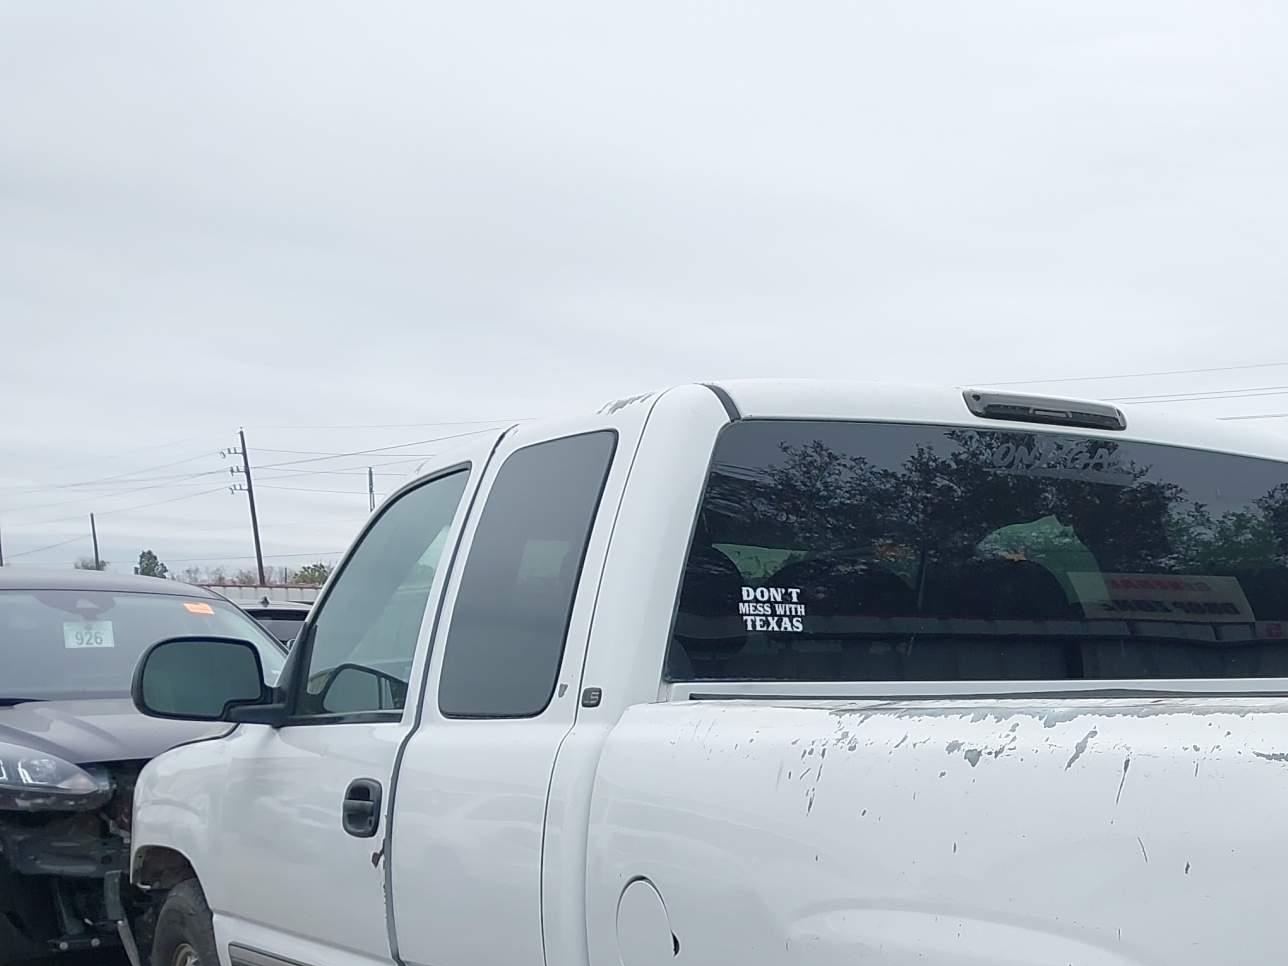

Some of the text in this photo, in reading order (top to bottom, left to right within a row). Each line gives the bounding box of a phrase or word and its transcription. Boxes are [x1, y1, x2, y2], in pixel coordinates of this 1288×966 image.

[741, 586, 801, 602] DON'T
[739, 602, 806, 616] MESS WITH
[742, 615, 804, 632] TEXAS
[75, 631, 104, 646] 926
